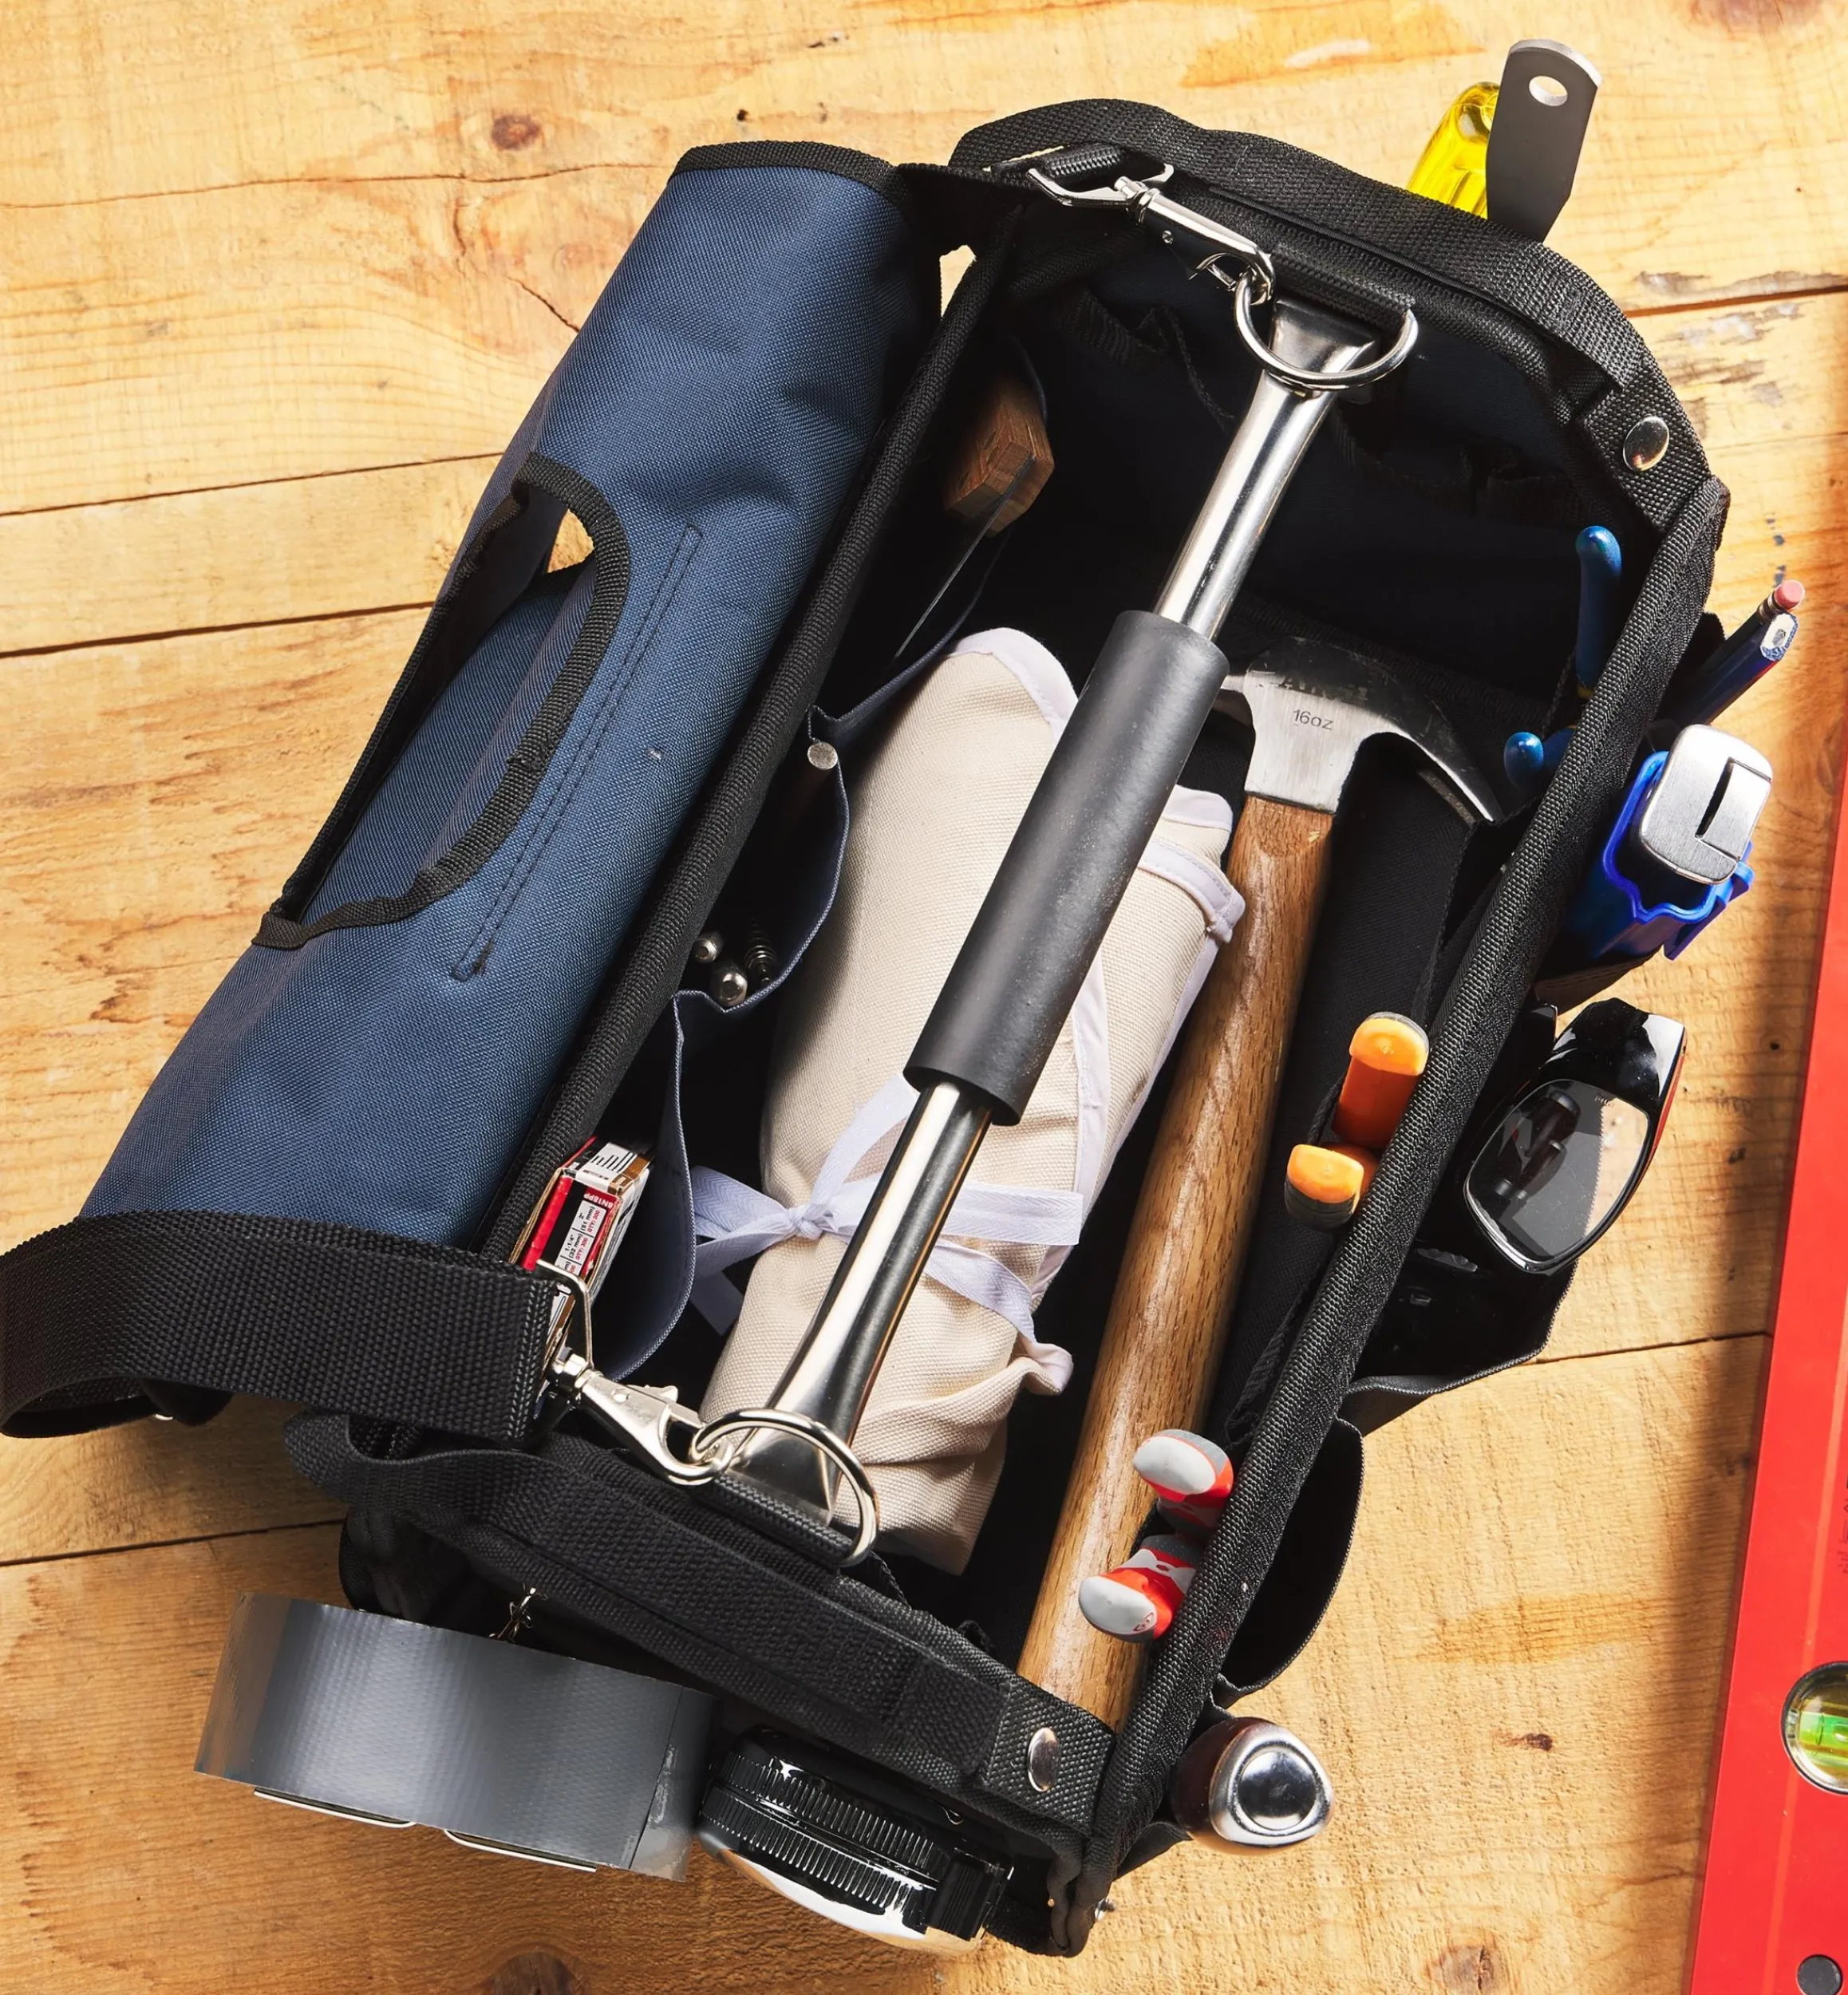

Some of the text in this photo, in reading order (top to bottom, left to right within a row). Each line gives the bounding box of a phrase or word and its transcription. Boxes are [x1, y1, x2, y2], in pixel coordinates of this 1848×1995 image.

[1293, 709, 1334, 730] 16oz
[586, 1206, 595, 1220] mm)
[575, 1234, 583, 1247] mm)
